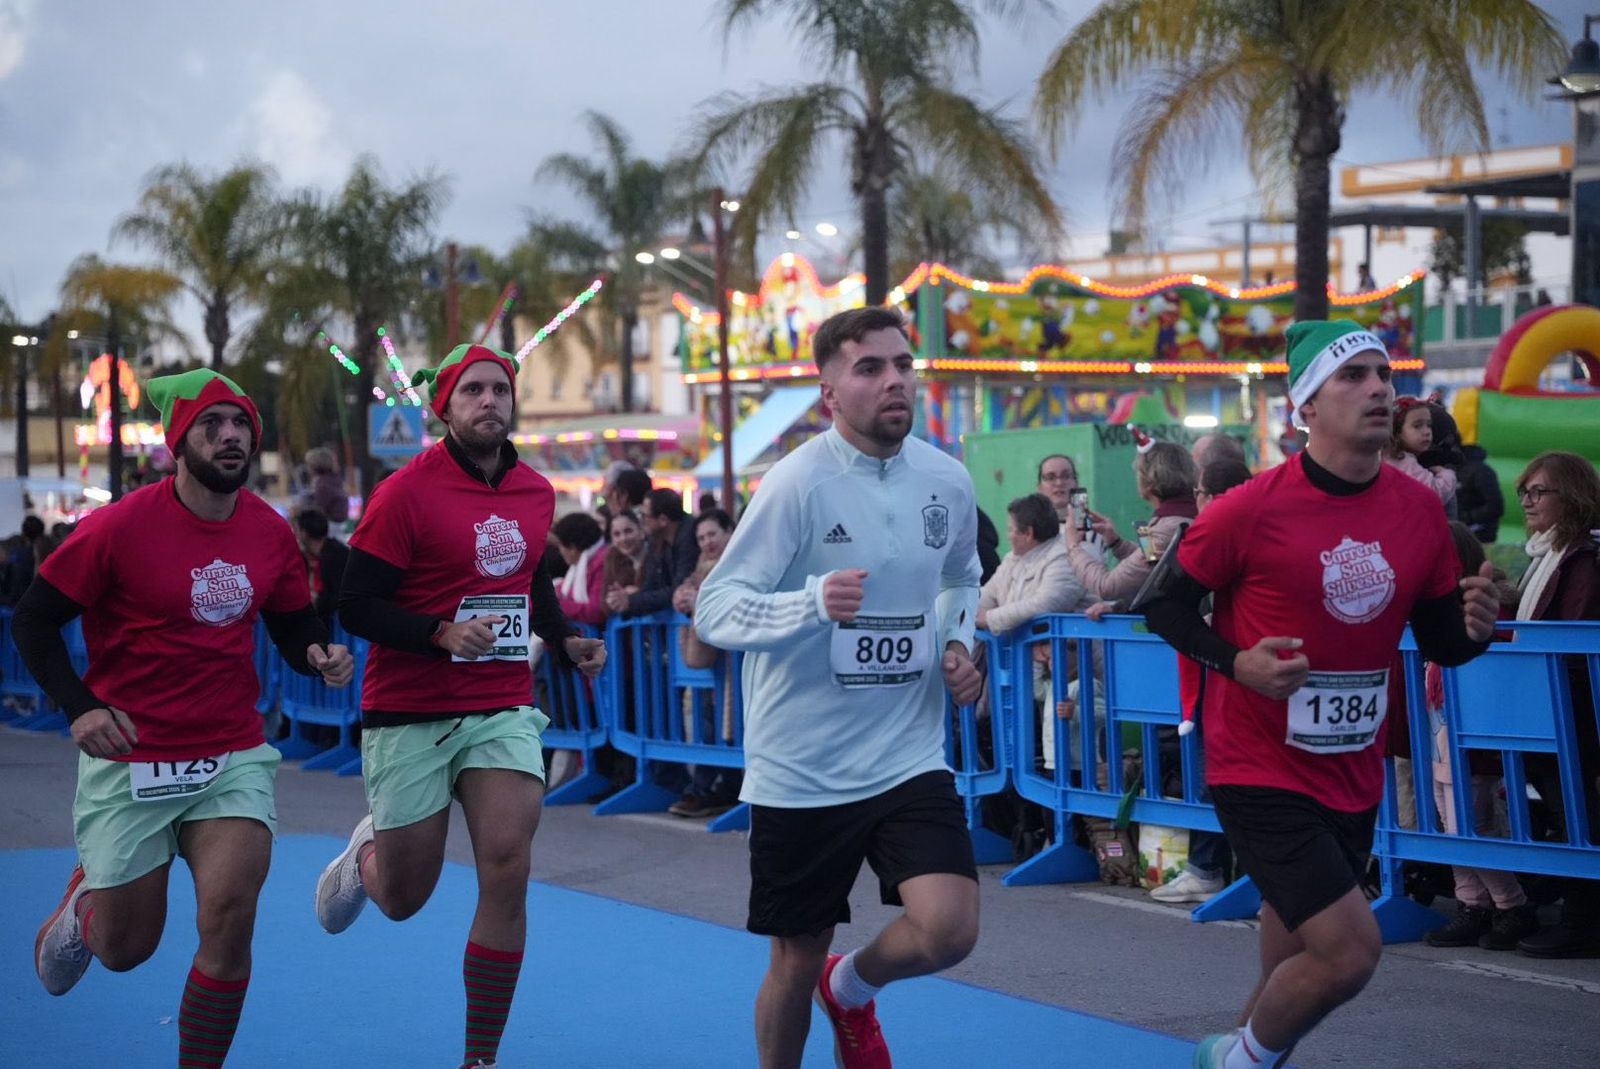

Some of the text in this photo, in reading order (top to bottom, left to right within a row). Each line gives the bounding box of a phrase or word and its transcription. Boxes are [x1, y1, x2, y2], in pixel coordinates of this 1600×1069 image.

[473, 519, 519, 535] Carrera
[489, 532, 513, 546] San
[823, 536, 852, 544] adidas
[477, 541, 527, 560] Silvestre
[1320, 541, 1382, 567] Carrera
[191, 564, 247, 580] Carrera
[1341, 560, 1374, 579] San
[208, 579, 238, 592] San
[1325, 568, 1396, 599] Silvestre
[192, 587, 254, 608] Silvestre
[856, 636, 913, 664] 809
[1306, 693, 1378, 725] 1384
